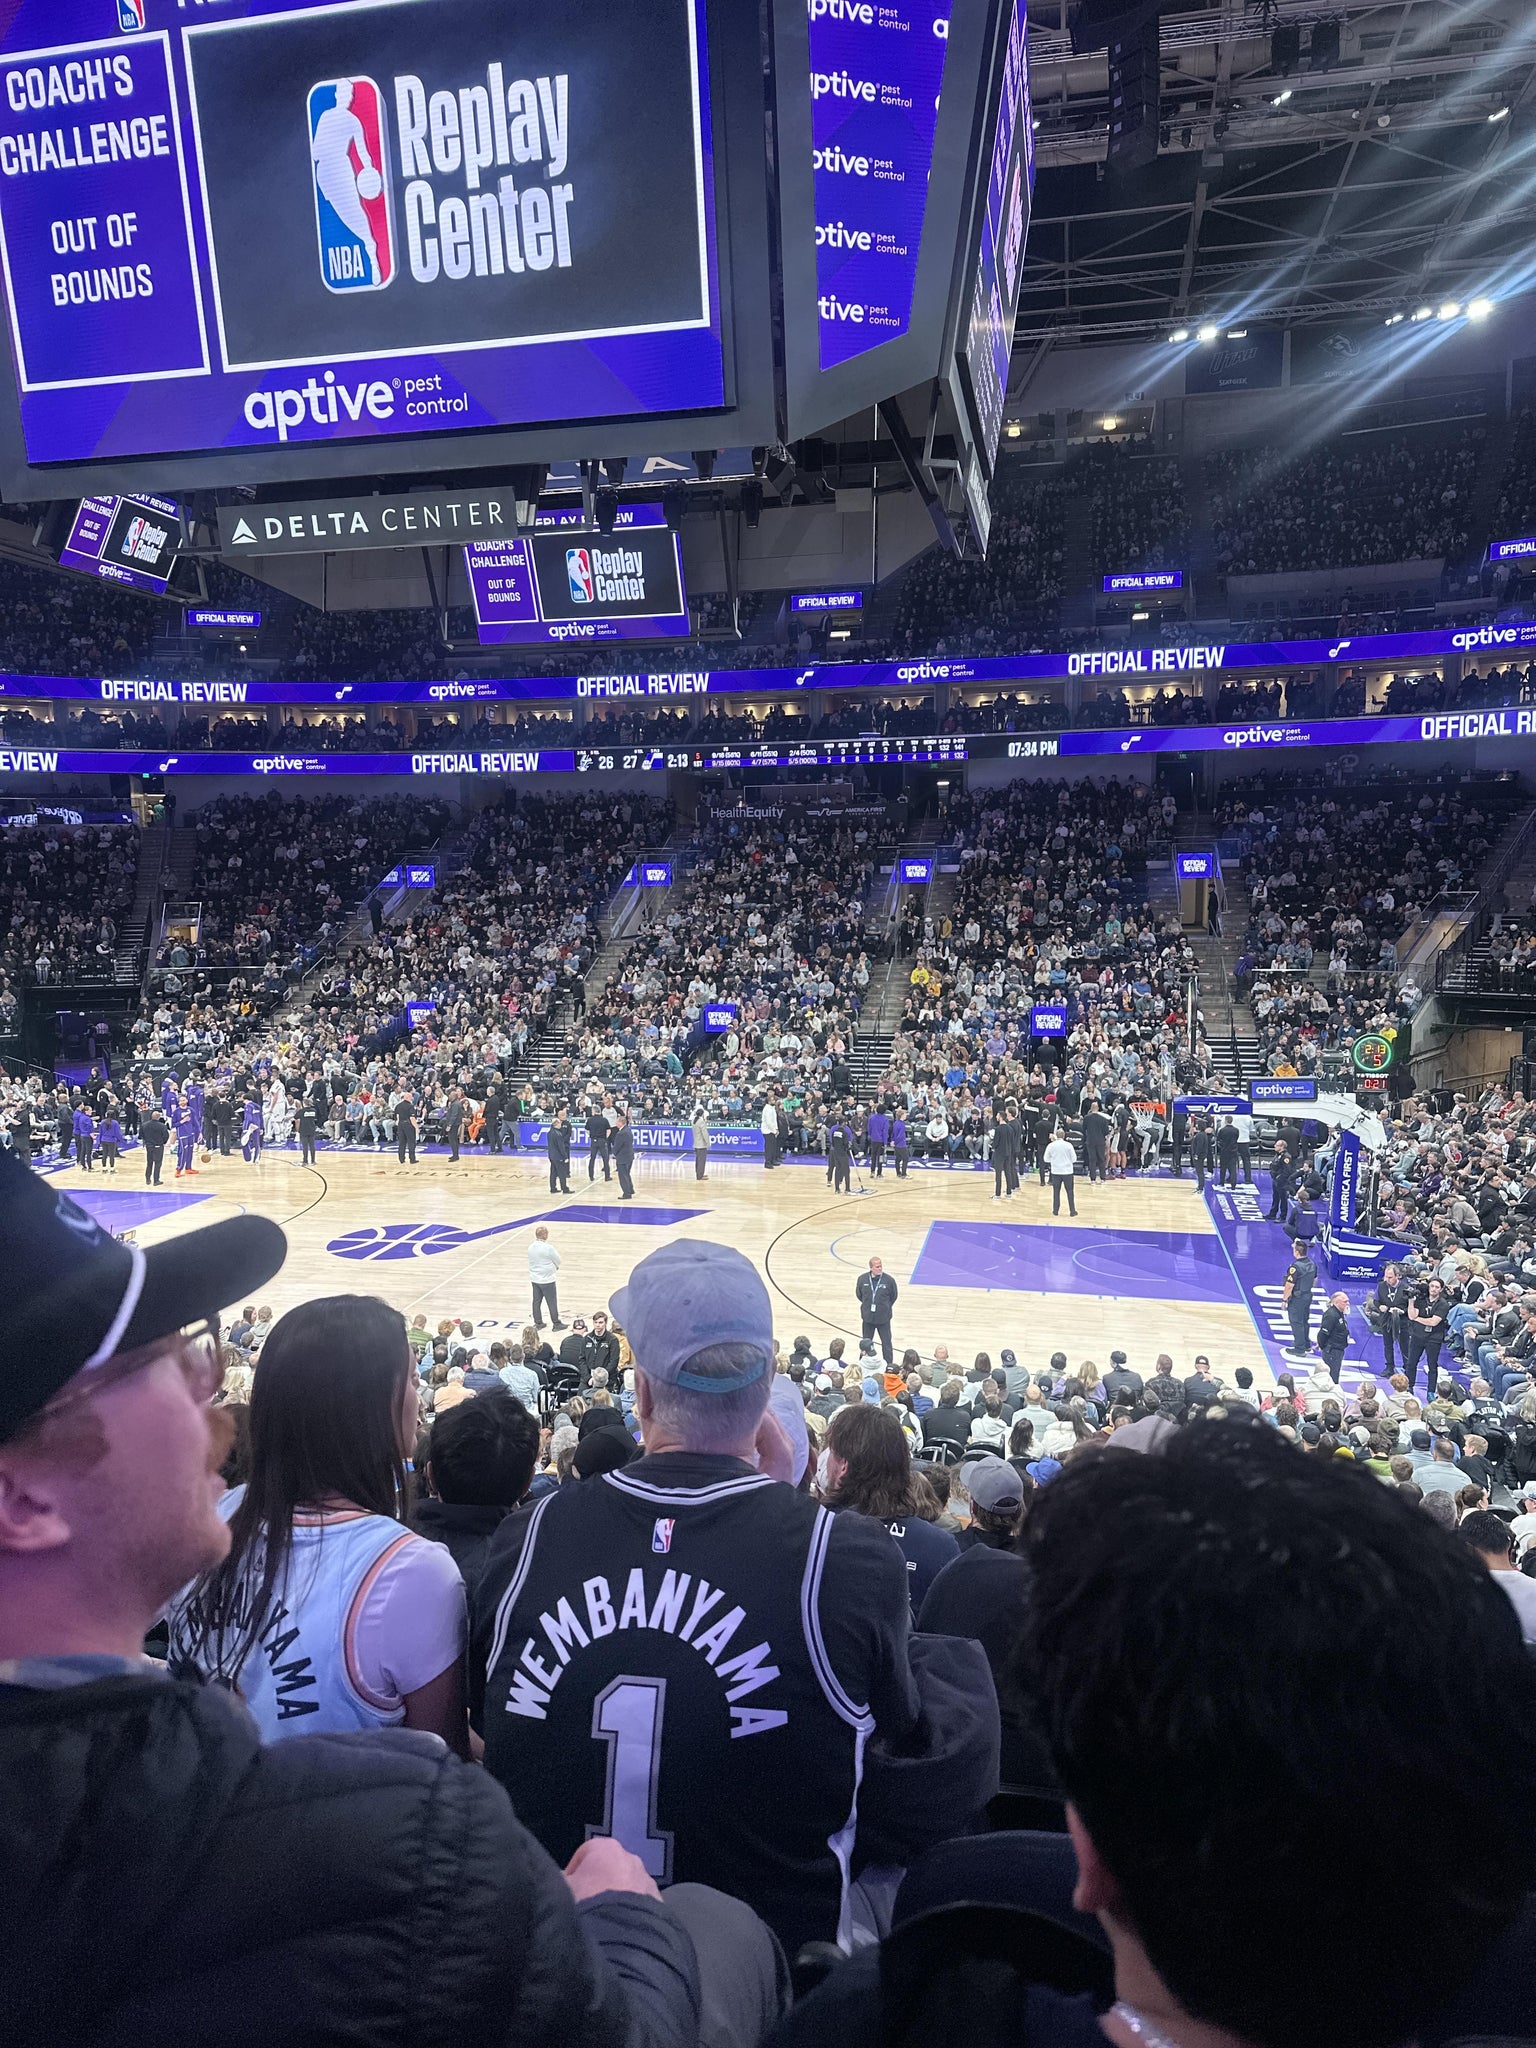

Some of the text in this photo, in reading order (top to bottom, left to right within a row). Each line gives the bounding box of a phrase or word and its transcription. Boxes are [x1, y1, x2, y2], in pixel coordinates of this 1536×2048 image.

[121, 13, 136, 27] NBA
[808, 0, 898, 24] ptive pest
[878, 18, 910, 31] control
[5, 55, 134, 112] COACH'S
[810, 70, 901, 102] ptive pest
[880, 95, 912, 108] control
[394, 61, 570, 189] Replay
[0, 114, 170, 175] CHALLENGE
[874, 158, 893, 169] pest
[873, 169, 905, 182] control
[51, 211, 137, 255] OUT OF
[405, 180, 574, 284] Center
[876, 233, 896, 244] pest
[876, 243, 907, 255] control
[328, 246, 364, 281] NBA
[52, 263, 153, 307] BOUNDS
[818, 294, 888, 323] tive pest
[869, 315, 900, 327] control
[404, 374, 442, 398] pest
[406, 392, 469, 416] control
[83, 500, 114, 518] CHALLENGE
[264, 501, 504, 540] DELTA CENTER
[471, 554, 526, 568] CHALLENGE
[591, 547, 643, 579] Replay
[487, 578, 516, 590] OUT OF
[595, 575, 646, 602] Center
[1111, 575, 1174, 588] OFFICIAL REVIEW
[488, 592, 521, 603] BOUNDS
[798, 596, 855, 607] OFFICIAL REVIEW
[196, 613, 254, 624] OFFICIAL REVIEW
[1067, 646, 1225, 675] OFFICIAL REVIEW
[100, 679, 247, 702] OFFICIAL REVIEW
[577, 673, 710, 697] OFFICIAL REVIEW
[1421, 714, 1512, 739] OFFICIAL
[1008, 740, 1058, 758] 07:34 PM
[0, 752, 58, 771] EVIEW
[412, 753, 539, 773] OFFICIAL REVIEW
[598, 756, 614, 770] 26
[623, 755, 638, 769] 27
[667, 754, 688, 768] 2:13
[710, 807, 784, 819] HealthEquity
[1365, 1044, 1386, 1054] 2:13
[1374, 1055, 1381, 1066] 5
[633, 1129, 685, 1147] REVIEW
[709, 1130, 739, 1146] ptive
[1340, 1150, 1353, 1223] AMERICA FIRST
[505, 1568, 788, 1739] WEMBANYAMA
[585, 1674, 674, 1885] 1
